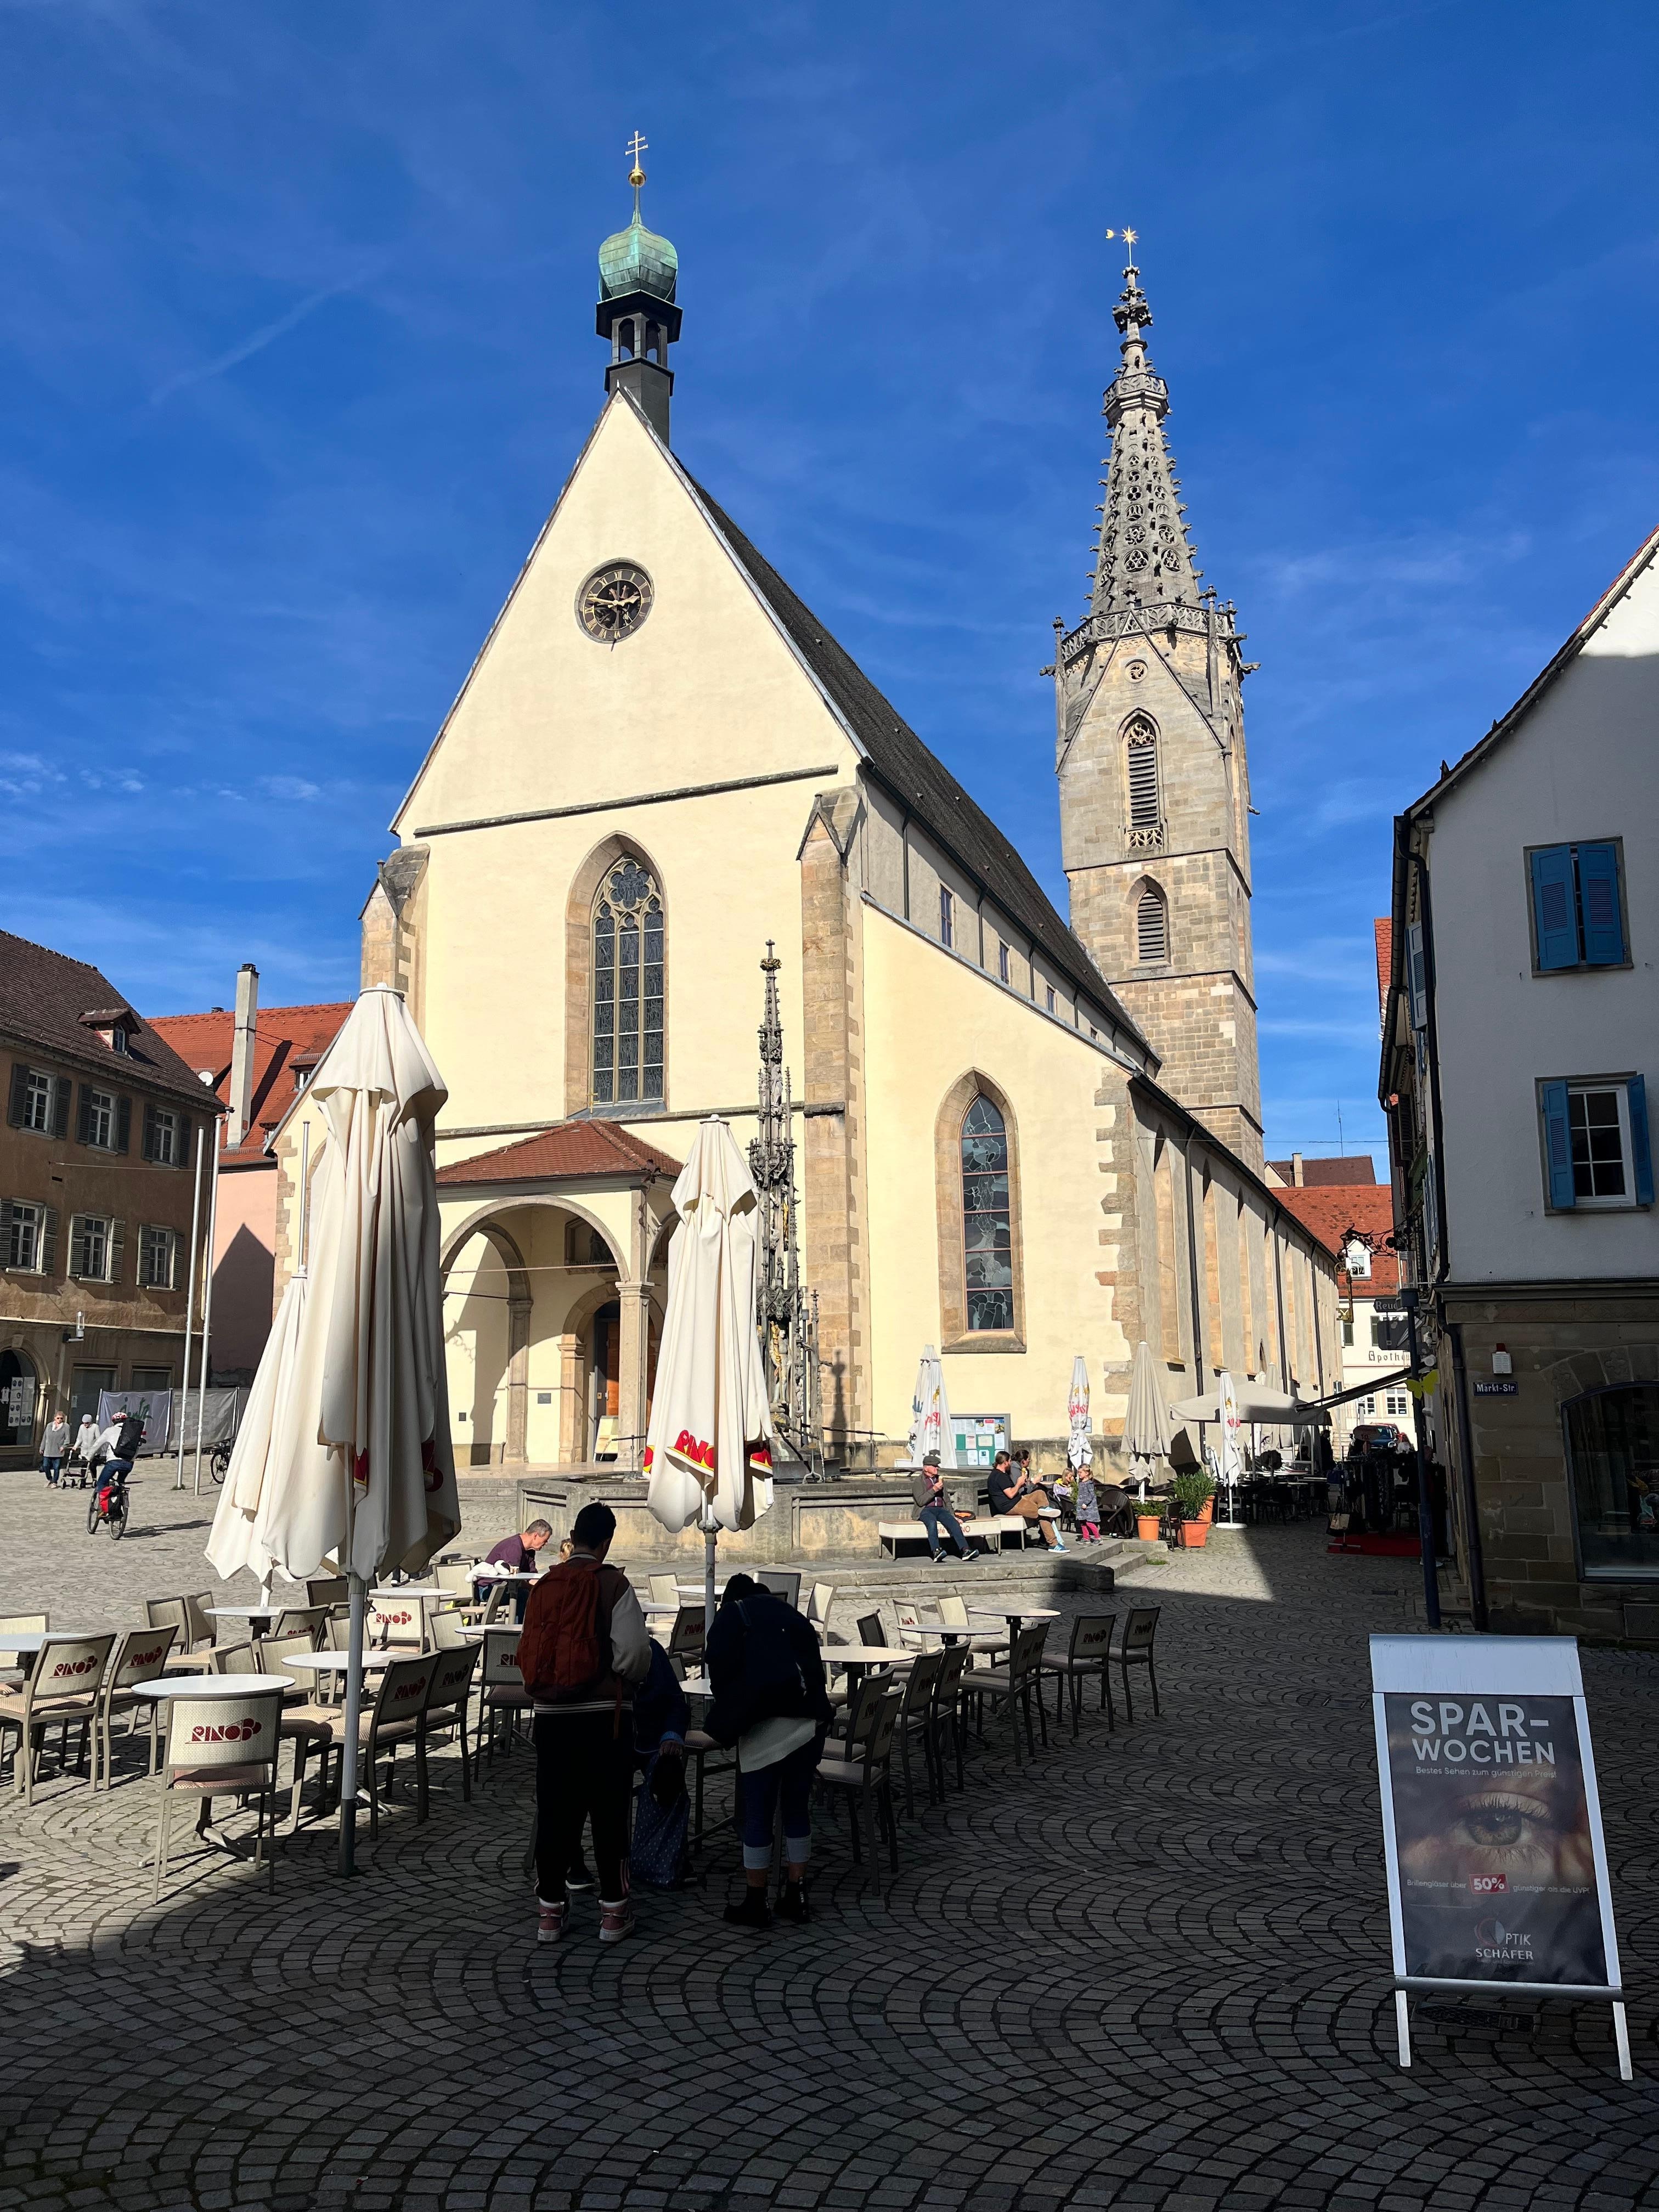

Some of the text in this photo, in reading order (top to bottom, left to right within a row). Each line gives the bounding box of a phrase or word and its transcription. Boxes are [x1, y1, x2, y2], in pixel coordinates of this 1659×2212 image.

[1477, 1384, 1516, 1392] Markt-Str.
[1410, 1701, 1549, 1737] SPAR-
[191, 1725, 240, 1742] PINO
[1412, 1738, 1555, 1765] WOCHEN
[1416, 1766, 1443, 1775] Bestes
[1444, 1767, 1470, 1776] Sehen
[1491, 1768, 1533, 1779] günstigen
[1534, 1770, 1557, 1778] Preis!
[1407, 1878, 1449, 1888] Brillengläser
[1473, 1877, 1505, 1891] 50%
[1513, 1884, 1545, 1893] günstiger
[1475, 1947, 1534, 1961] SCHÄFER
